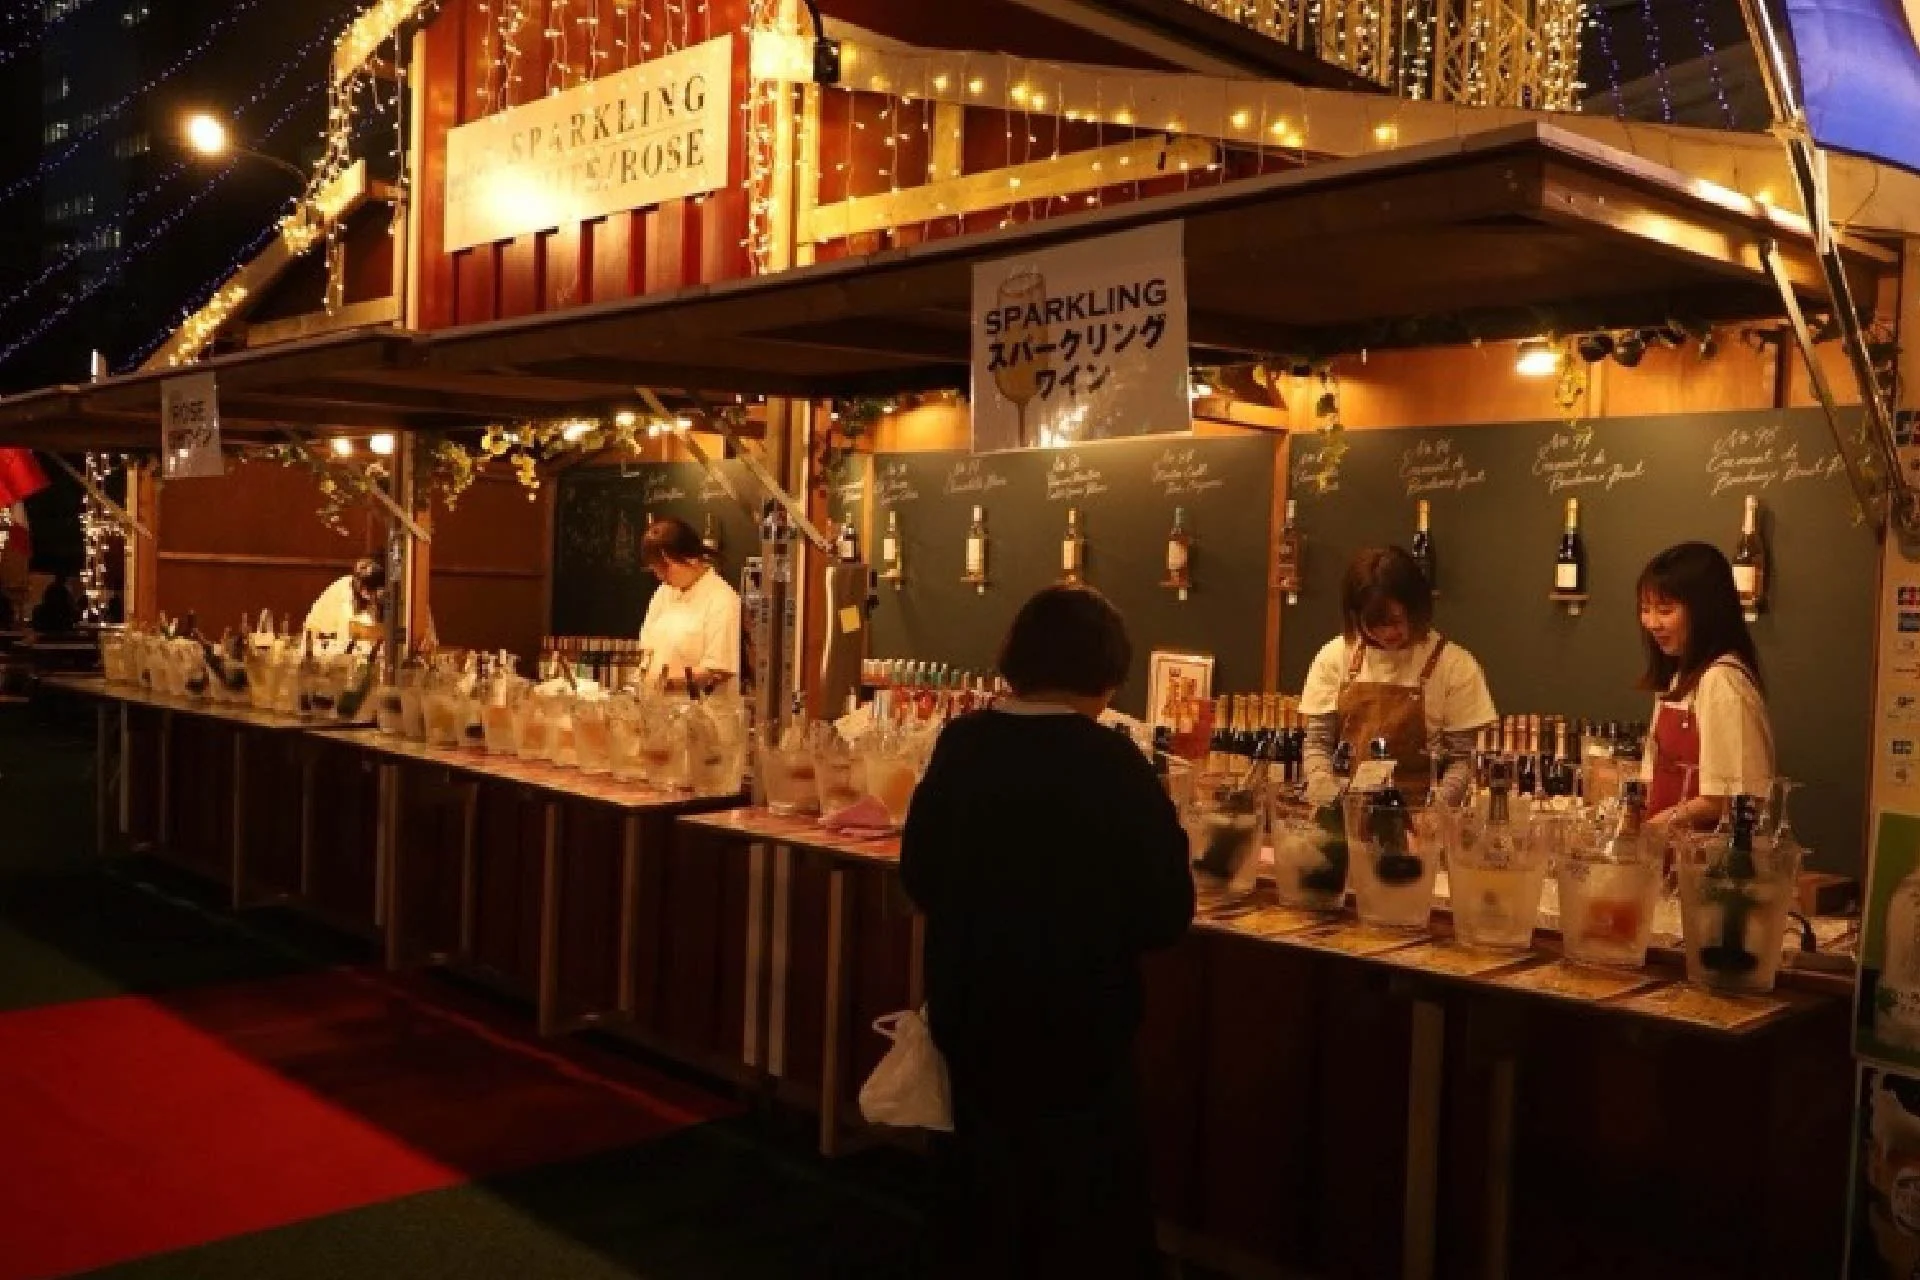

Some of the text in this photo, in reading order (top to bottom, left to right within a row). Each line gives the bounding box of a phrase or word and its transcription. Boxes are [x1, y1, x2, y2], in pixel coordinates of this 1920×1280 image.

[510, 75, 706, 163] SPARKLING
[984, 278, 1168, 336] SPARKLING
[987, 313, 1168, 372] スパークリング
[1035, 364, 1111, 401] ワイン
